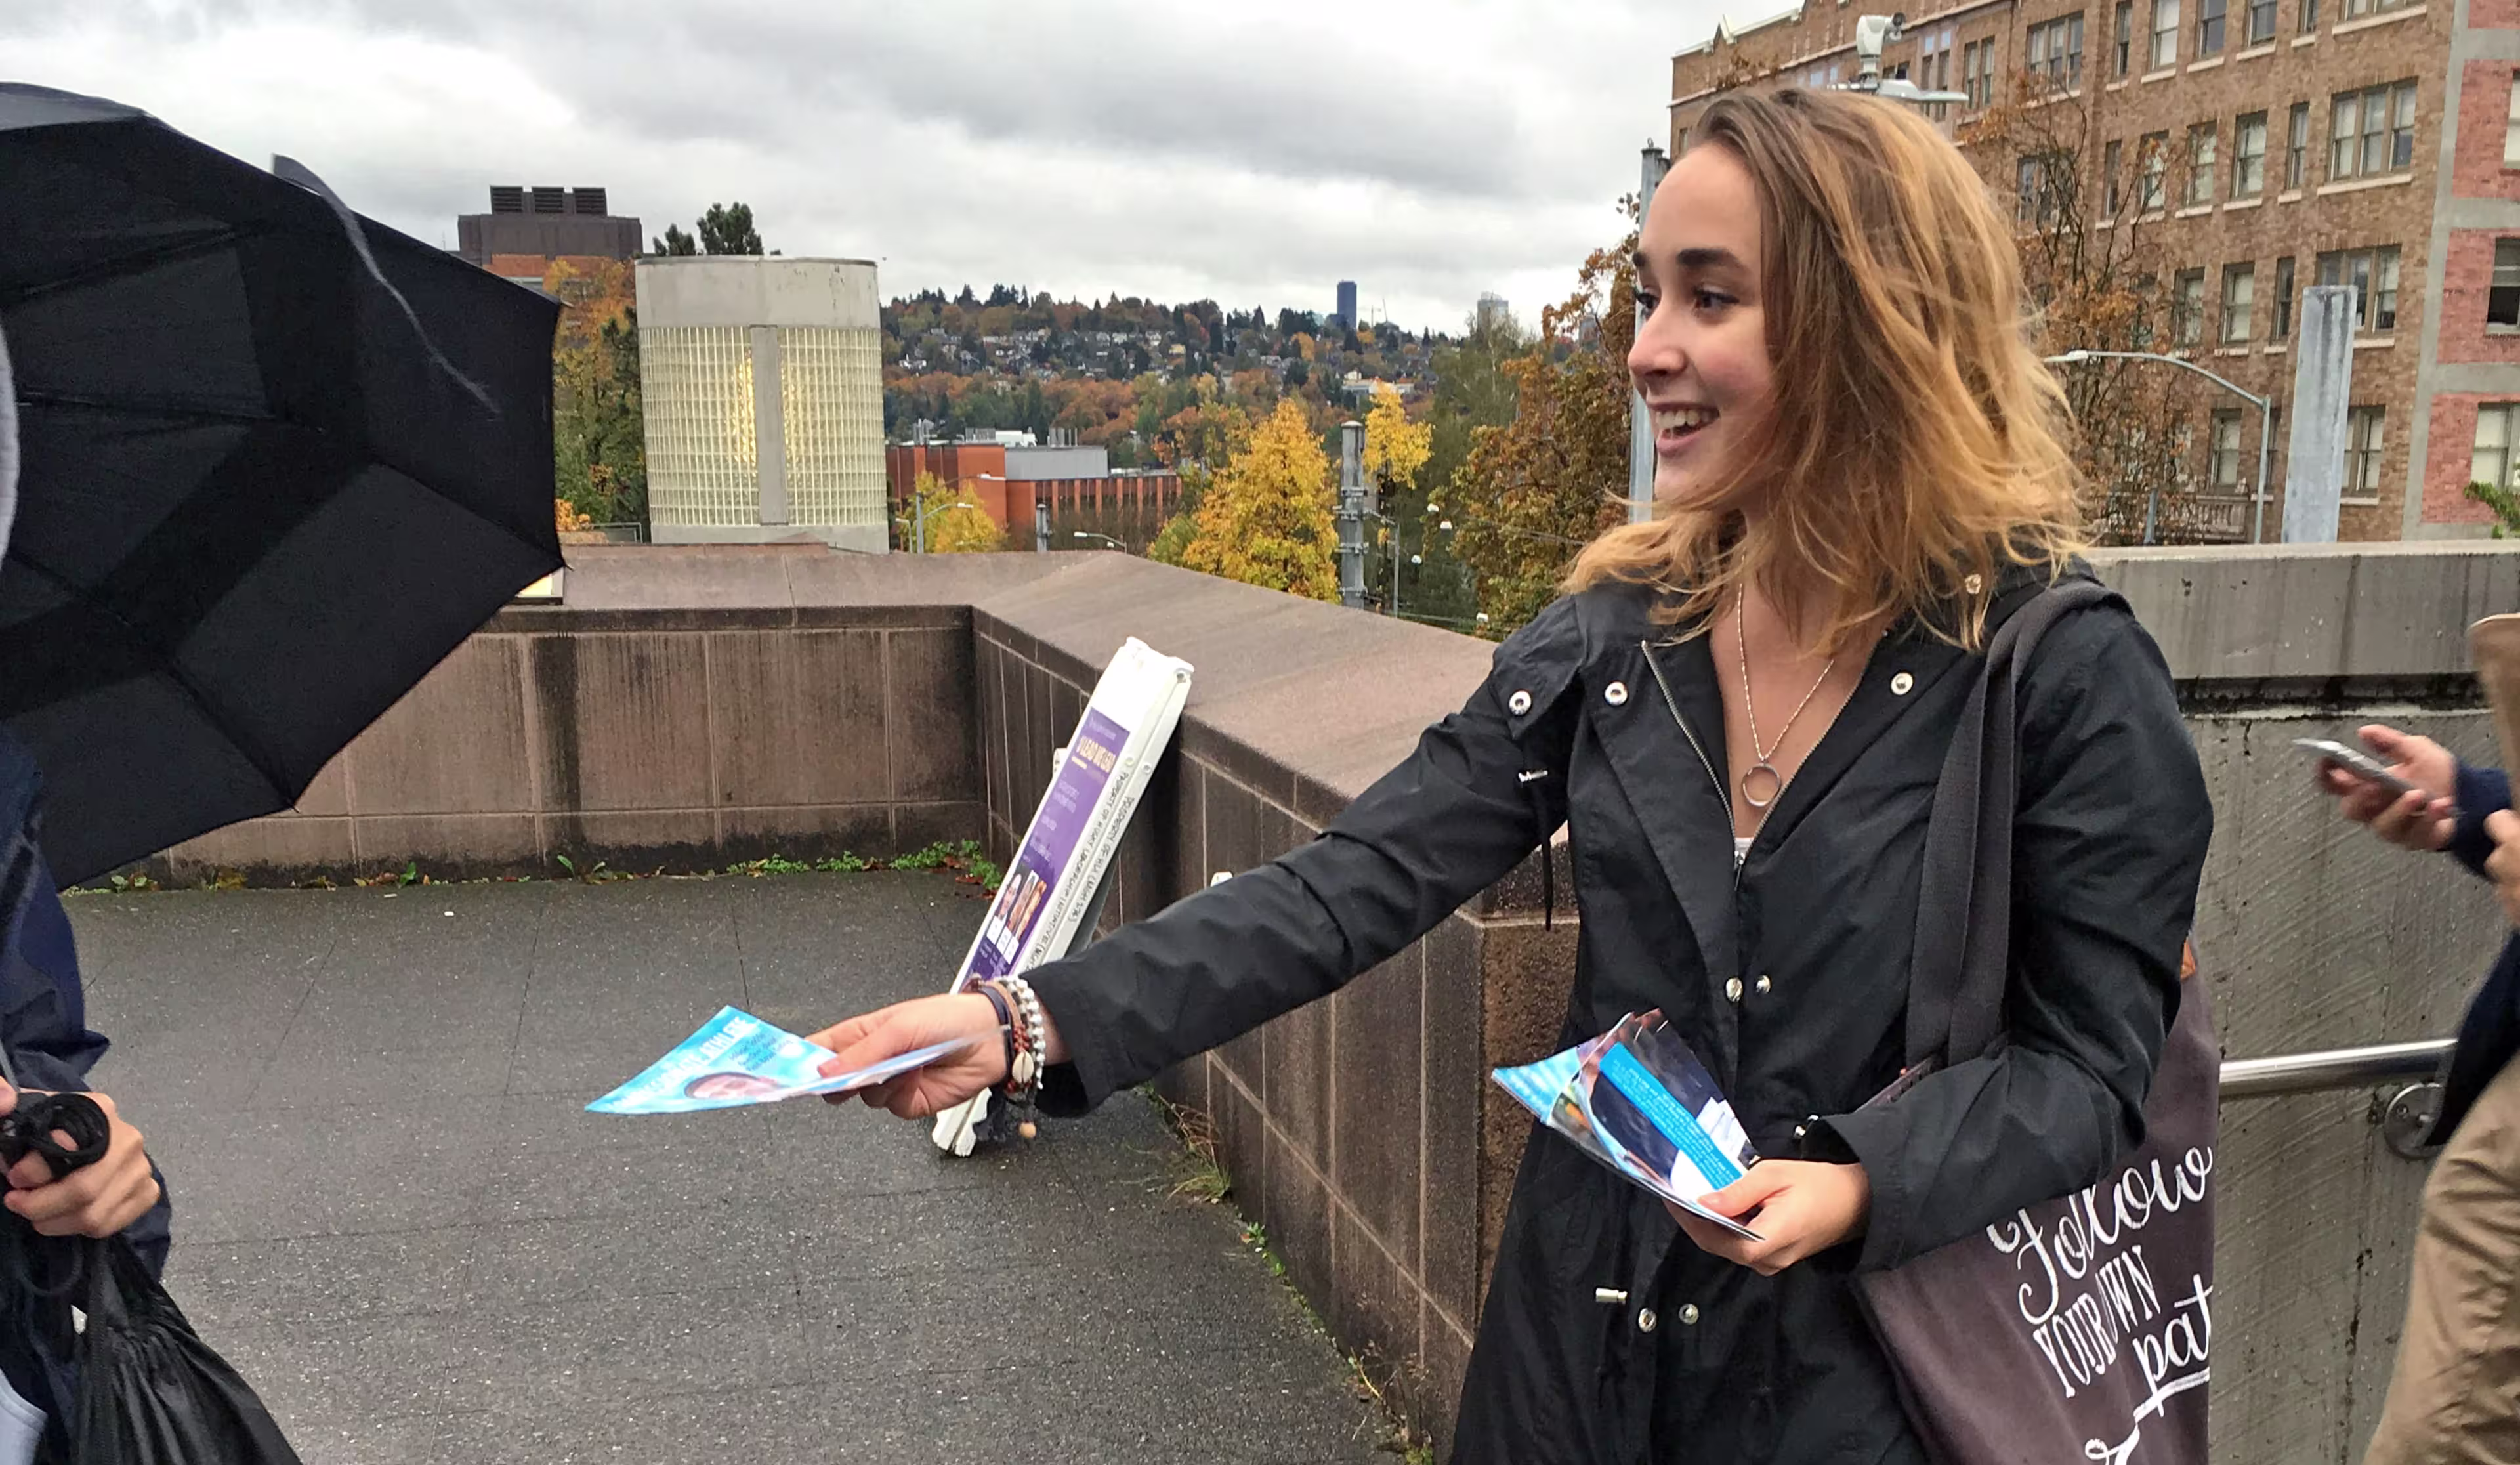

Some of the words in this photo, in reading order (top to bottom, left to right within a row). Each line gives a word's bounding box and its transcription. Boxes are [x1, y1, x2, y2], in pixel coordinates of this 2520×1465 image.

[1106, 772, 1129, 807] PROPERTY
[1087, 821, 1102, 847] HUSKY
[1101, 809, 1109, 820] OF
[1107, 796, 1135, 841] PROPERTY
[1101, 843, 1111, 856] OF
[1041, 897, 1066, 944] INITIATIVE
[1986, 1146, 2213, 1325] Follow
[2033, 1292, 2116, 1398] YOUR
[2132, 1273, 2213, 1418] pat
